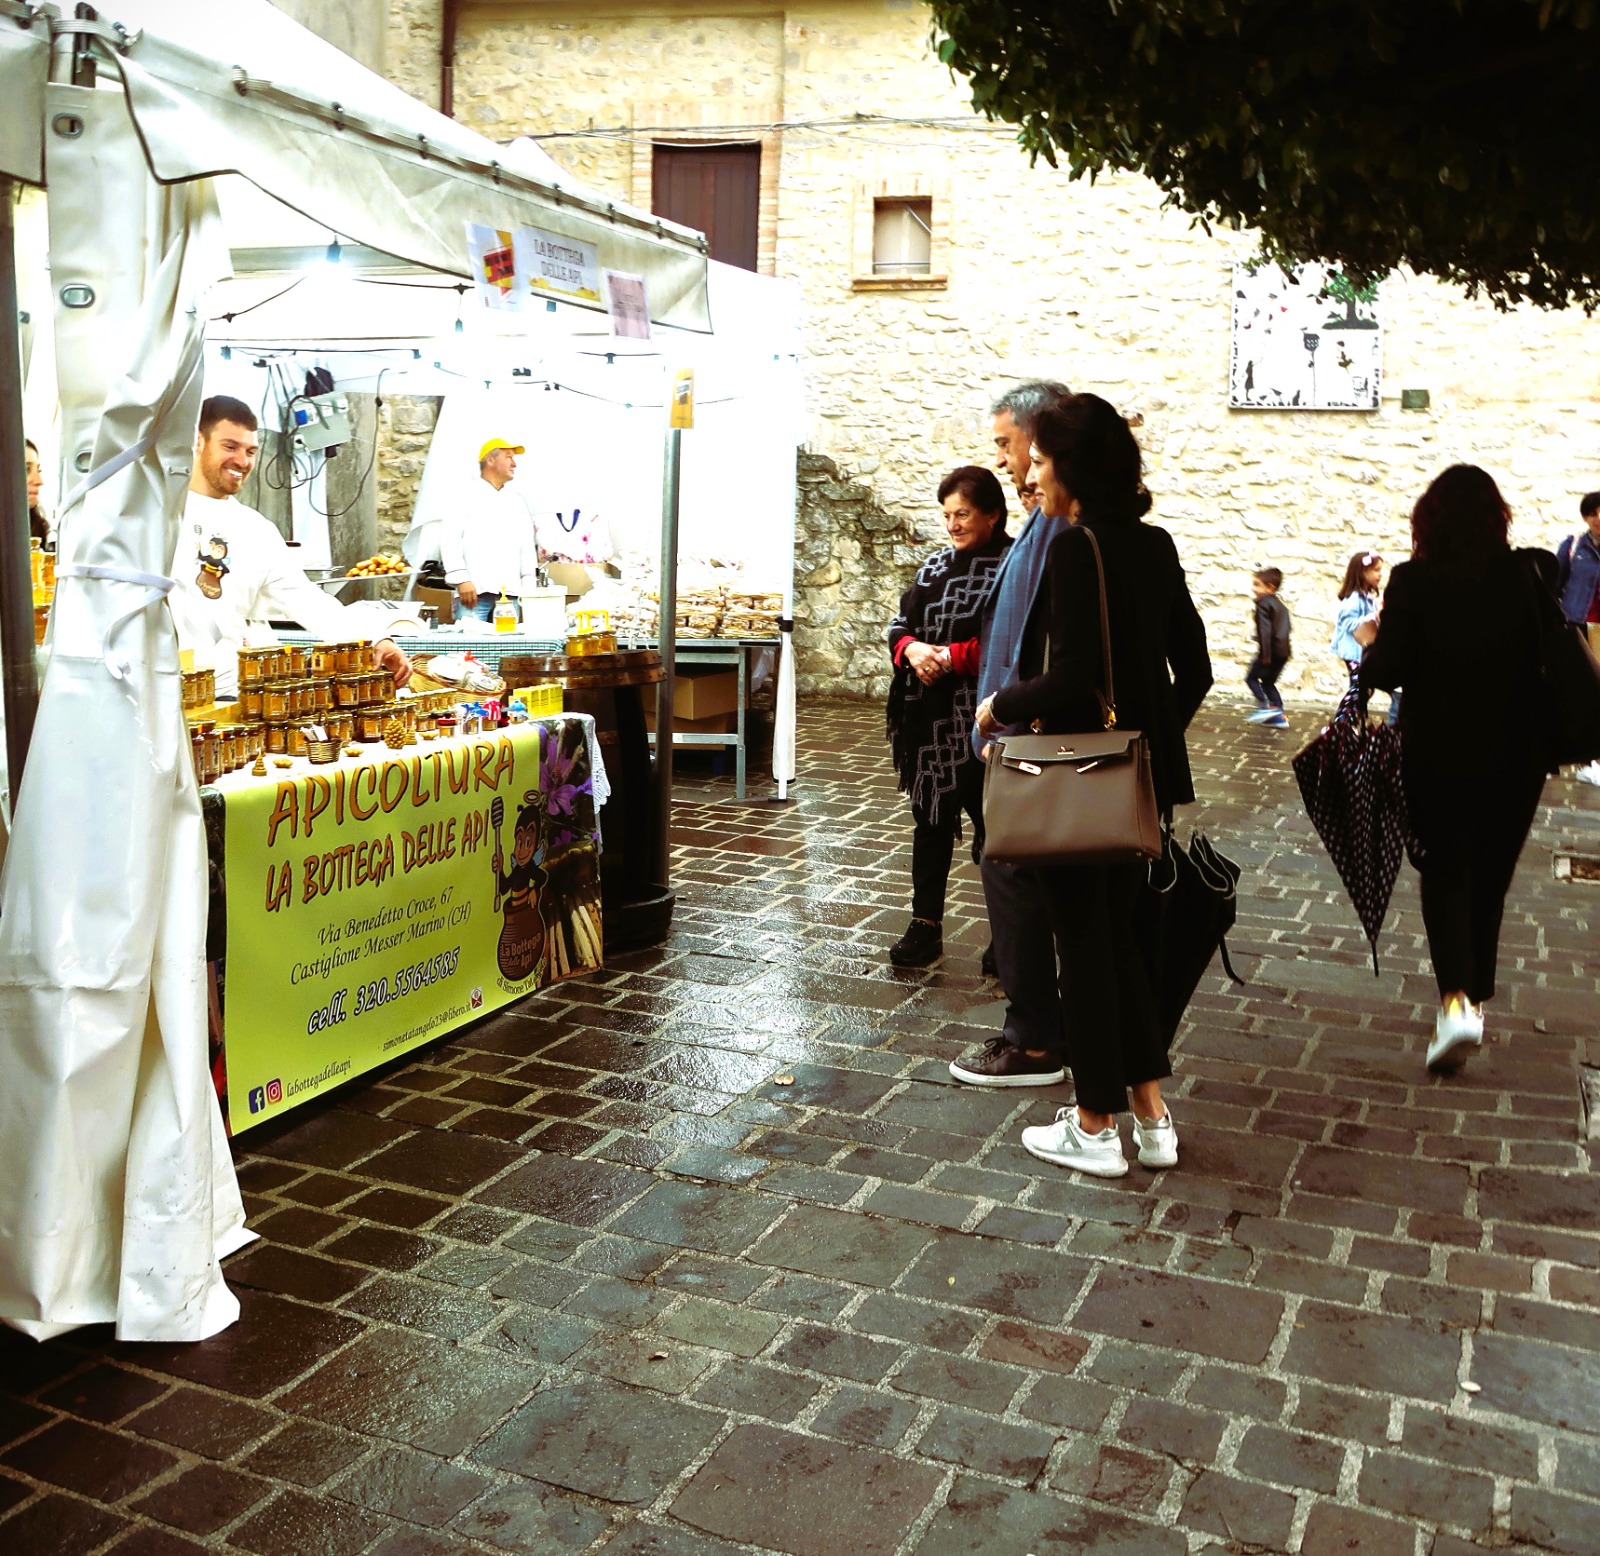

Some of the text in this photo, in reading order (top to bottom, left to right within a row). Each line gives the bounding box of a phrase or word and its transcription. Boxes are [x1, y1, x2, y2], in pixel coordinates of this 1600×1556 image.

[534, 239, 585, 267] LA BOTTEGA
[541, 261, 582, 285] DELLE API
[267, 735, 515, 847] APICOLTURA
[265, 808, 489, 912] LA BOTTEGA DELLE API
[291, 900, 472, 985] Castiglione Messer Marino (CH)
[317, 886, 454, 946] Via Benedetto Croce, 67
[307, 946, 460, 1035] cell. 320.5564585
[503, 981, 524, 995] Simone
[382, 1001, 471, 1051] simonetatangelo23@libero.it
[286, 1056, 352, 1098] labottegadelleapi
